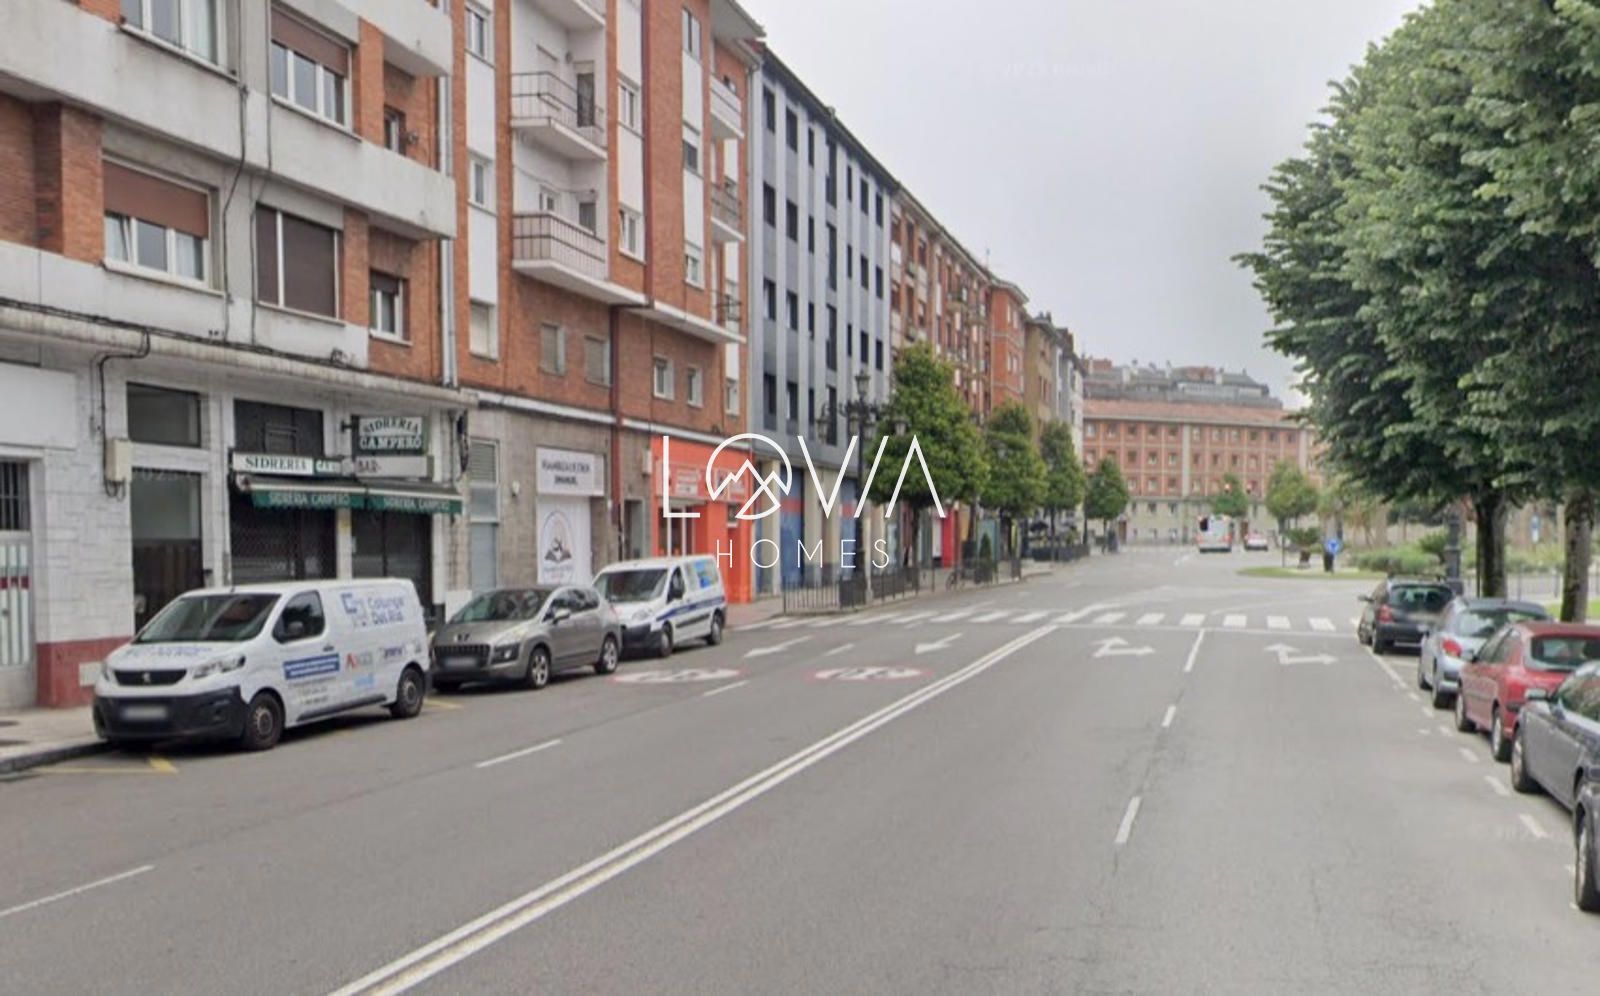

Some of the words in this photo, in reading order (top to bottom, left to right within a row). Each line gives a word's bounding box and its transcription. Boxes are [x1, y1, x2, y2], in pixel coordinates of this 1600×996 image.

[362, 416, 420, 433] SIDRERIA
[360, 435, 422, 450] CAMPERO
[245, 456, 307, 470] SIDRERIA
